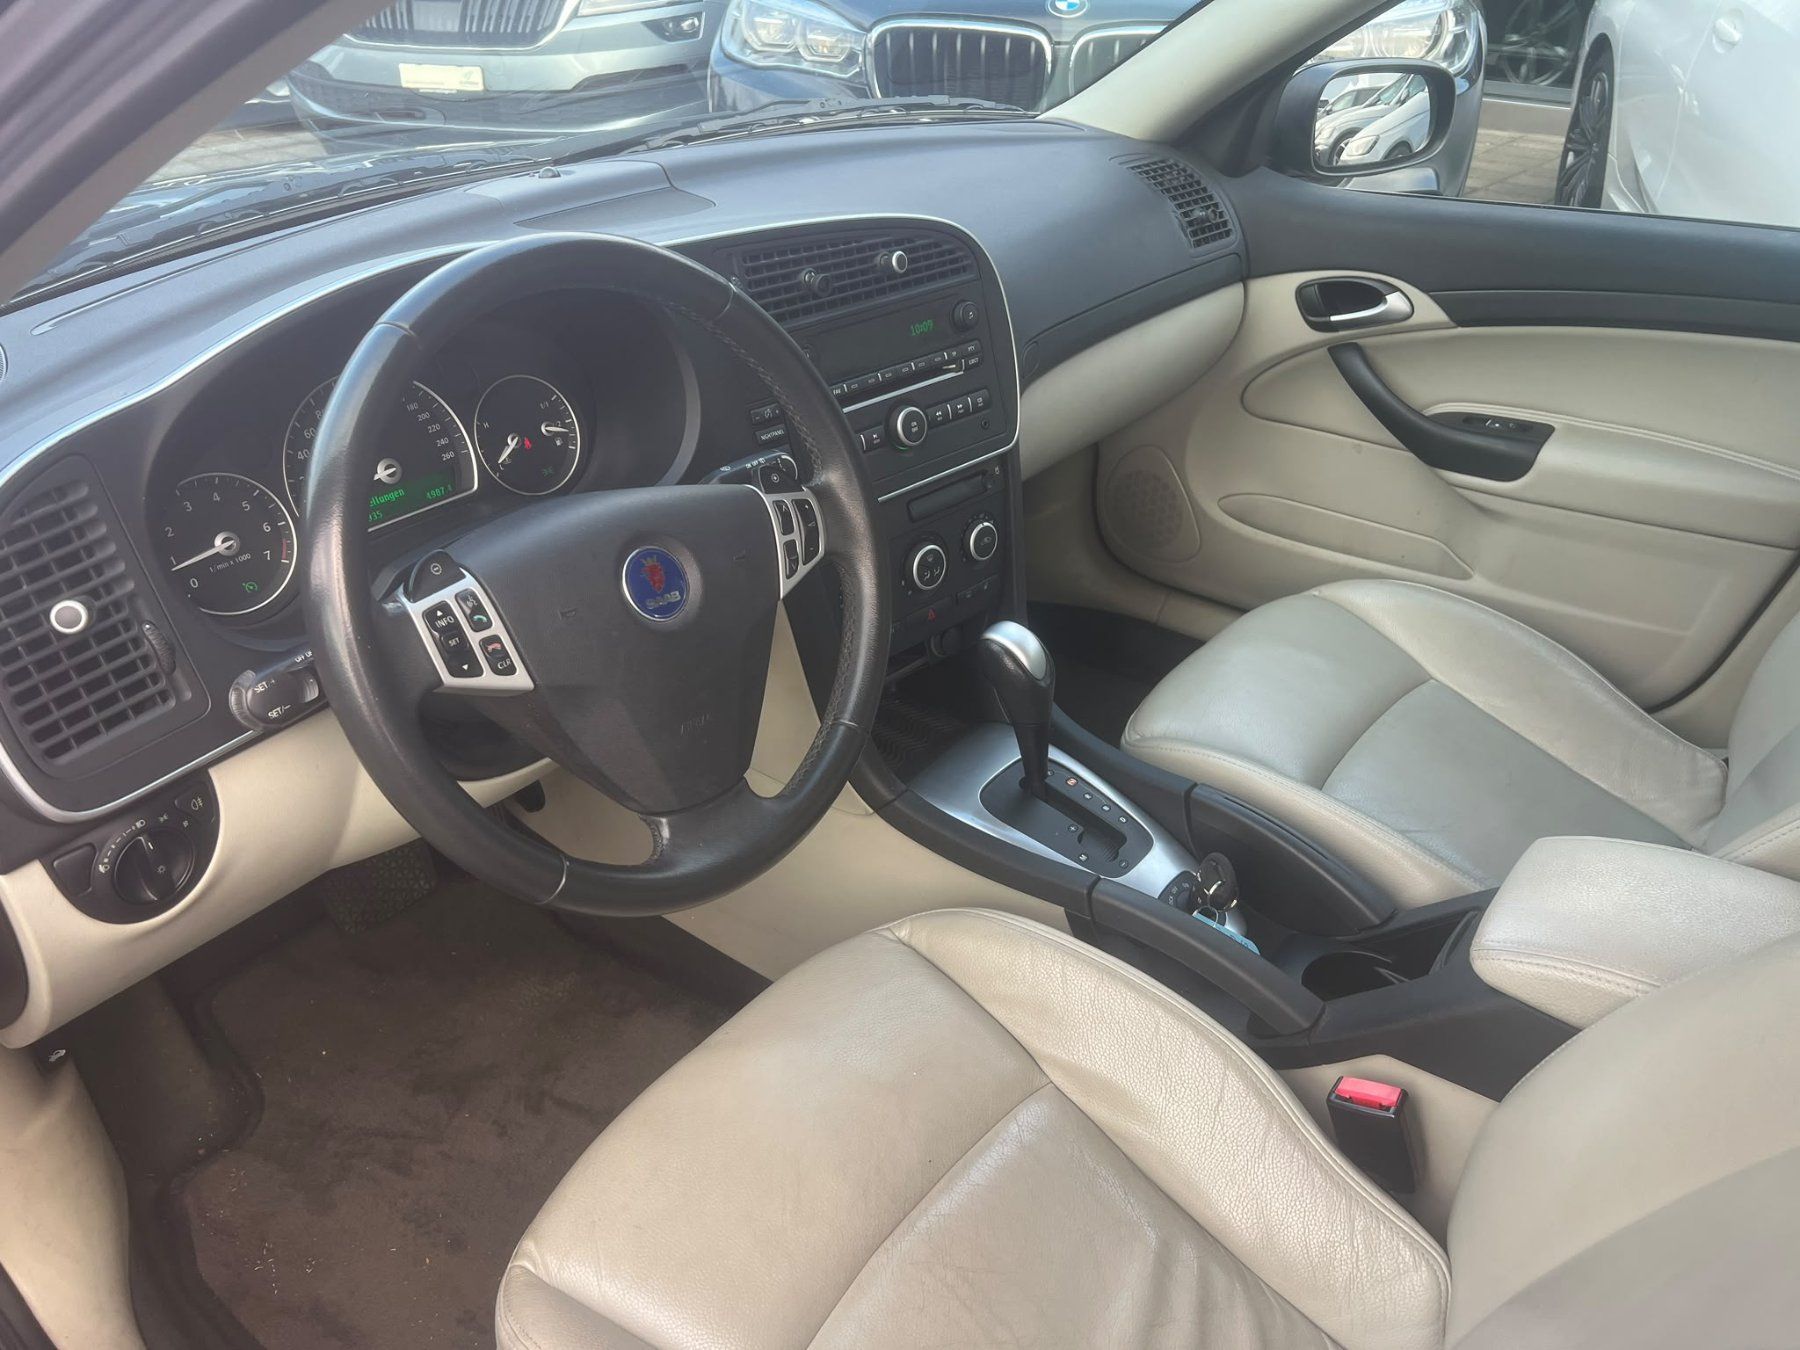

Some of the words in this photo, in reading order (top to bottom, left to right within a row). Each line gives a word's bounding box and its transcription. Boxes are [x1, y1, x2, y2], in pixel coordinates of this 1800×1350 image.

[417, 412, 431, 422] 200
[303, 427, 316, 439] 60
[427, 423, 441, 433] 220
[436, 437, 449, 447] 240
[297, 448, 311, 460] 40
[441, 451, 455, 461] 260
[212, 492, 220, 502] 4
[183, 501, 193, 512] 3
[242, 500, 251, 511] 5
[164, 526, 175, 537] 2
[262, 522, 272, 532] 6
[263, 550, 272, 561] 7
[189, 577, 199, 588] 0
[646, 591, 681, 609] SAAB
[434, 616, 455, 628] INFO
[448, 637, 460, 647] SET
[497, 659, 511, 669] CLR
